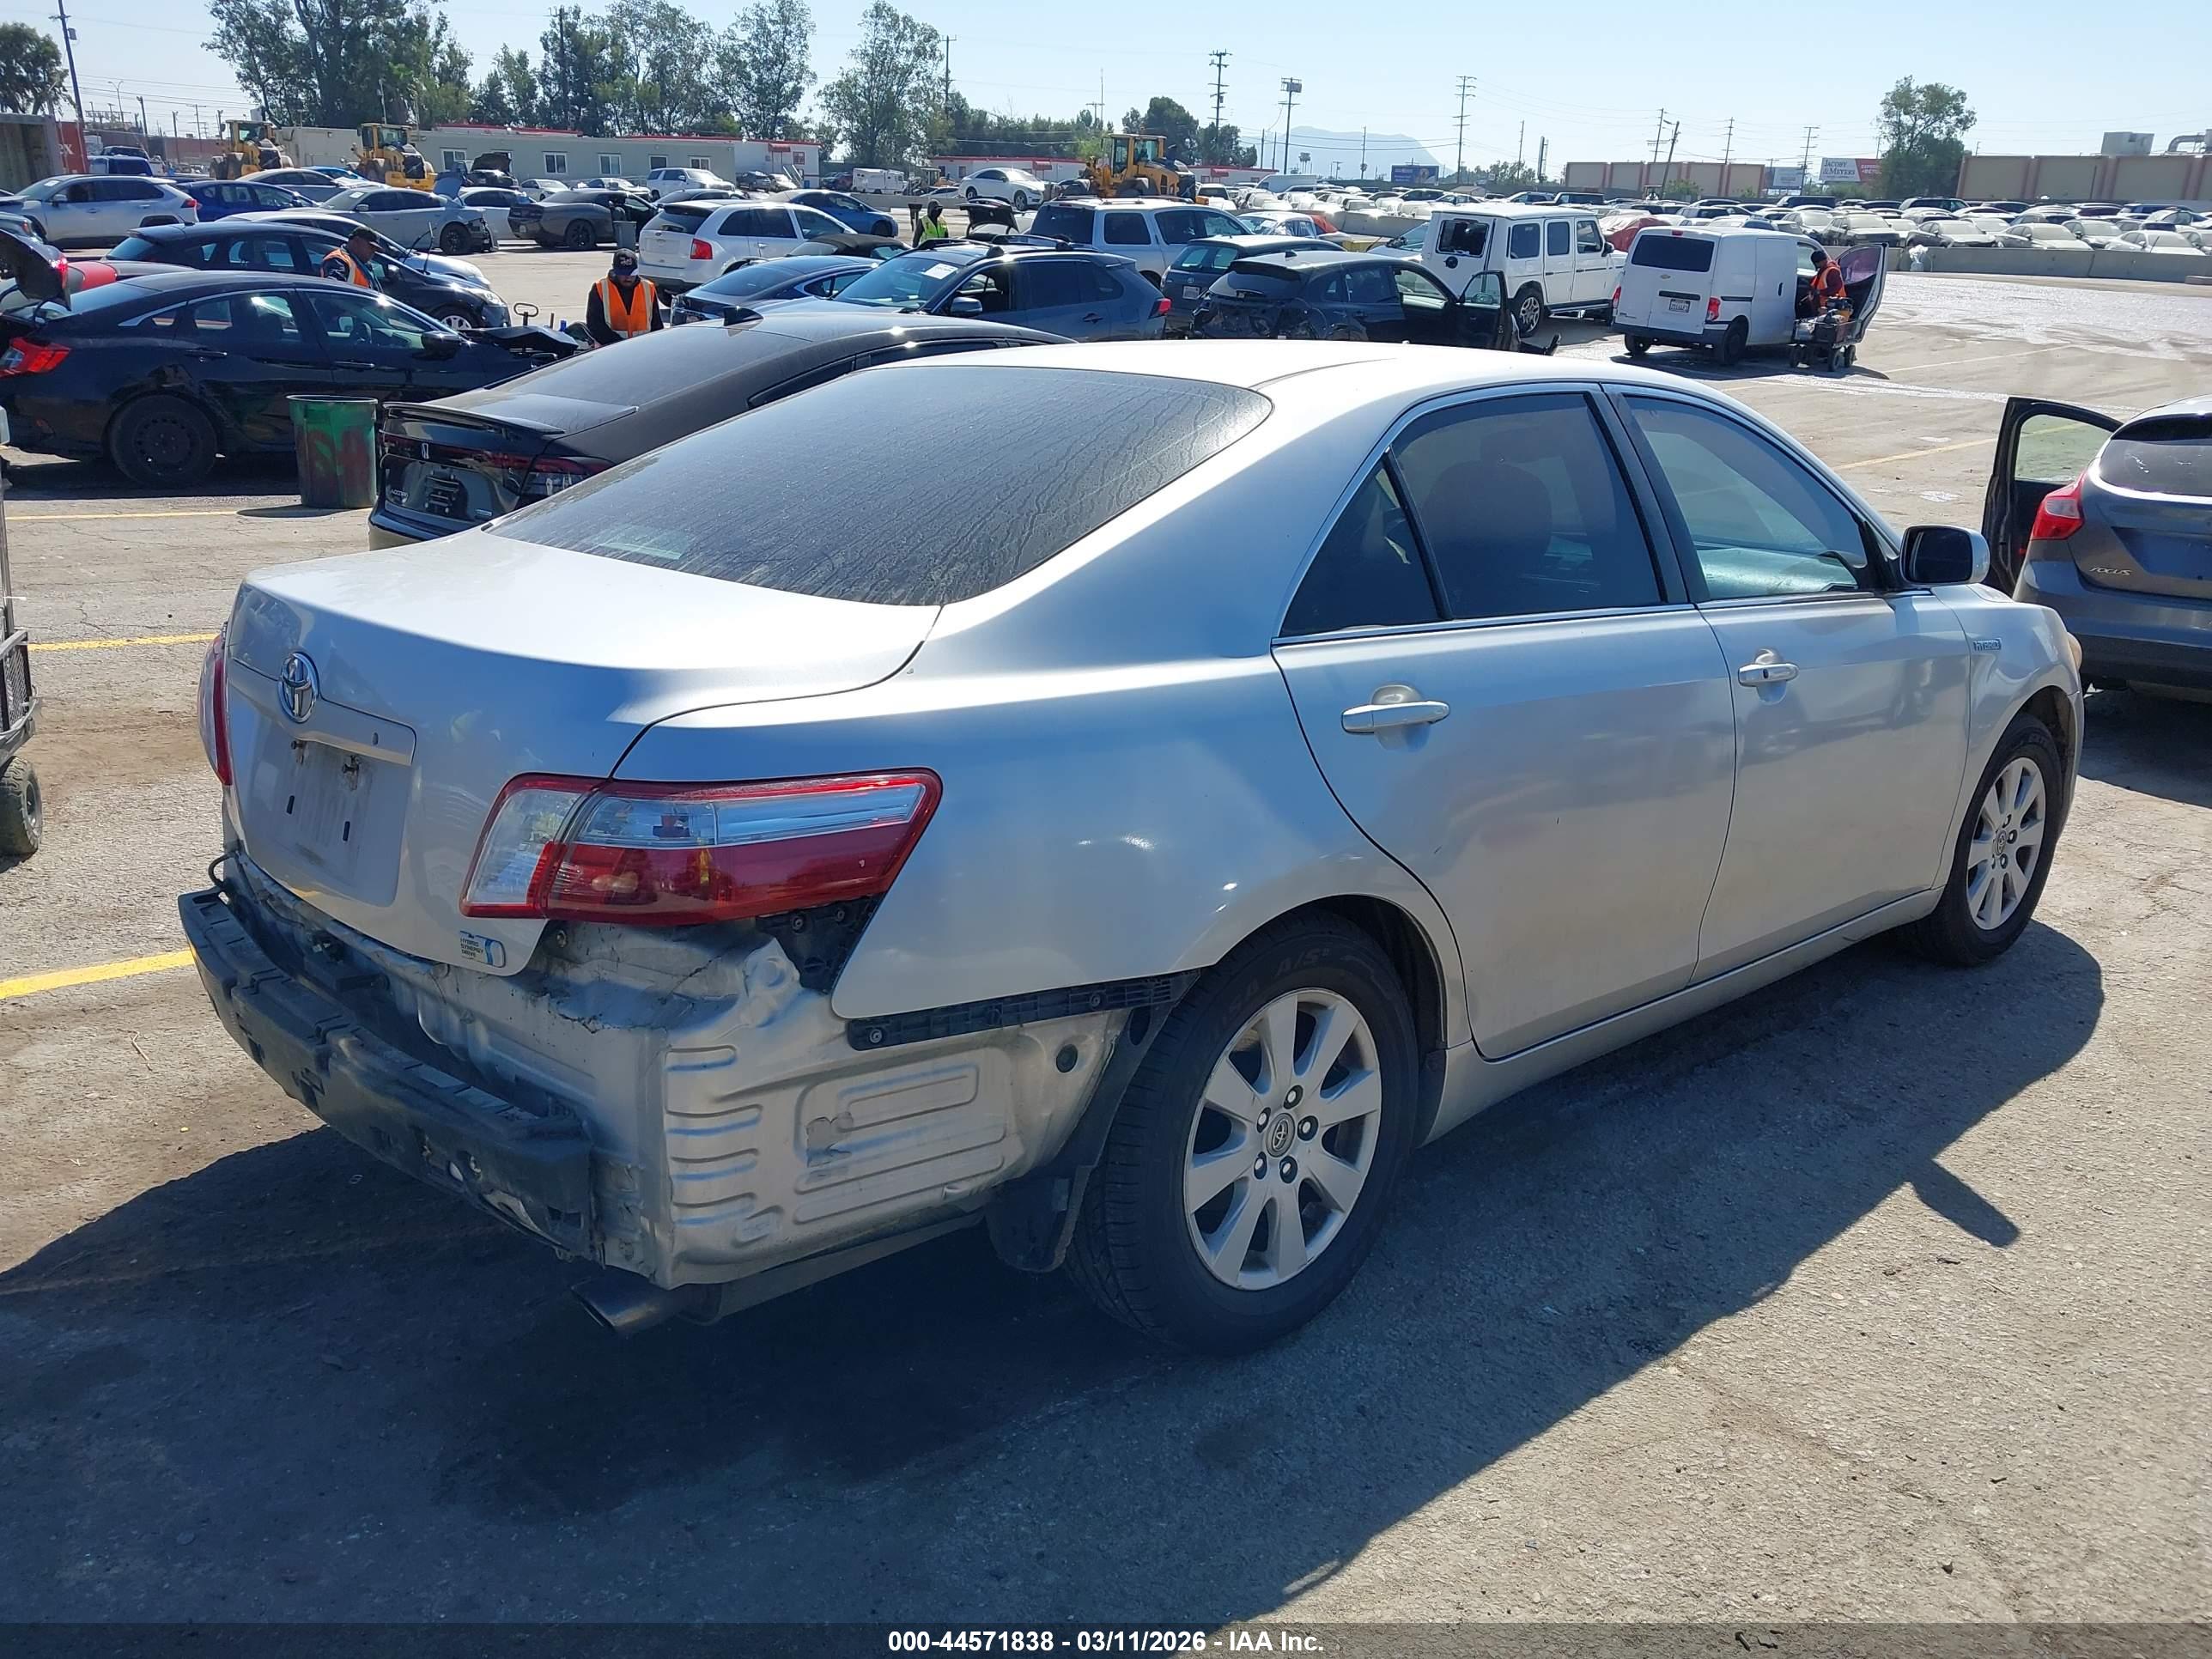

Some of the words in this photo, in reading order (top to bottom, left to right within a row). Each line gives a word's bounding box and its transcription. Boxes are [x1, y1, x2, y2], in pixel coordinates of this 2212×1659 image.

[2088, 566, 2131, 576] FOCUS
[1972, 639, 2001, 651] HYBRID
[460, 938, 479, 947] HYBRID
[460, 943, 483, 953] SYNERGY
[461, 949, 477, 957] DRIVE
